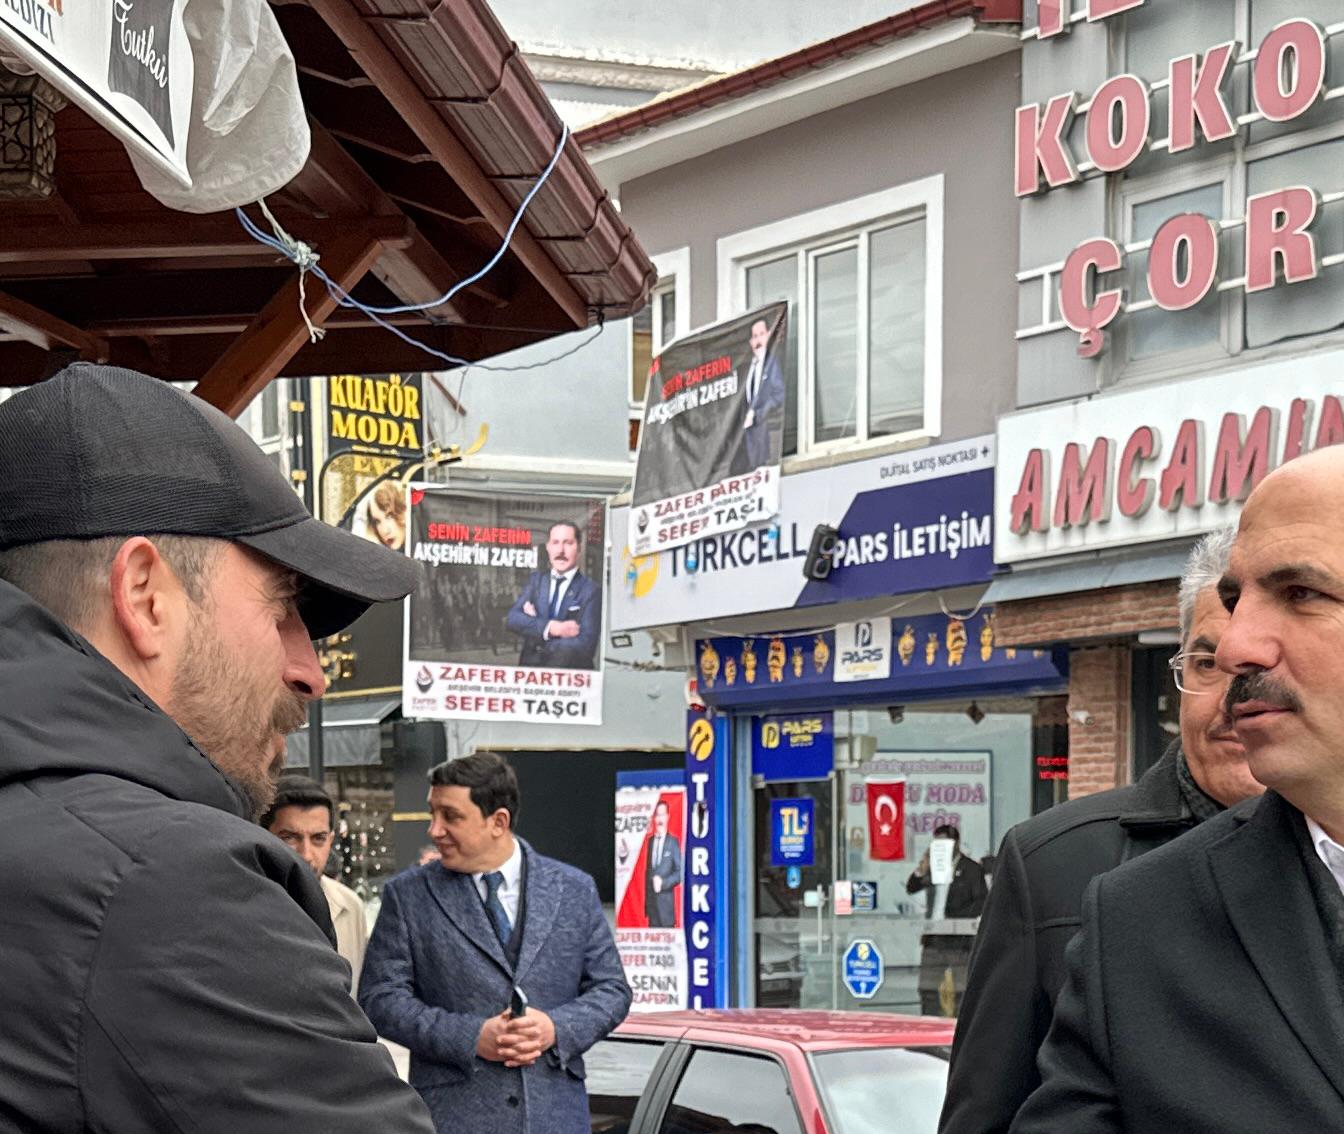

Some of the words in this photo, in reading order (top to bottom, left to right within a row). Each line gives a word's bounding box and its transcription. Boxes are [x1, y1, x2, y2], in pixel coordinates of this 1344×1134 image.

[332, 409, 420, 449] MODA
[654, 491, 704, 518] ZAFER
[427, 522, 471, 541] SENİN
[832, 531, 888, 570] PARS
[893, 510, 992, 560] İLETİŞİM
[491, 545, 538, 569] ZAFERİ
[439, 666, 507, 684] ZAFER
[514, 670, 592, 688] PARTİSİ
[444, 694, 517, 714] SEFER
[523, 699, 587, 719] TAŞCI
[923, 783, 986, 804] MODA
[623, 954, 647, 967] EFER
